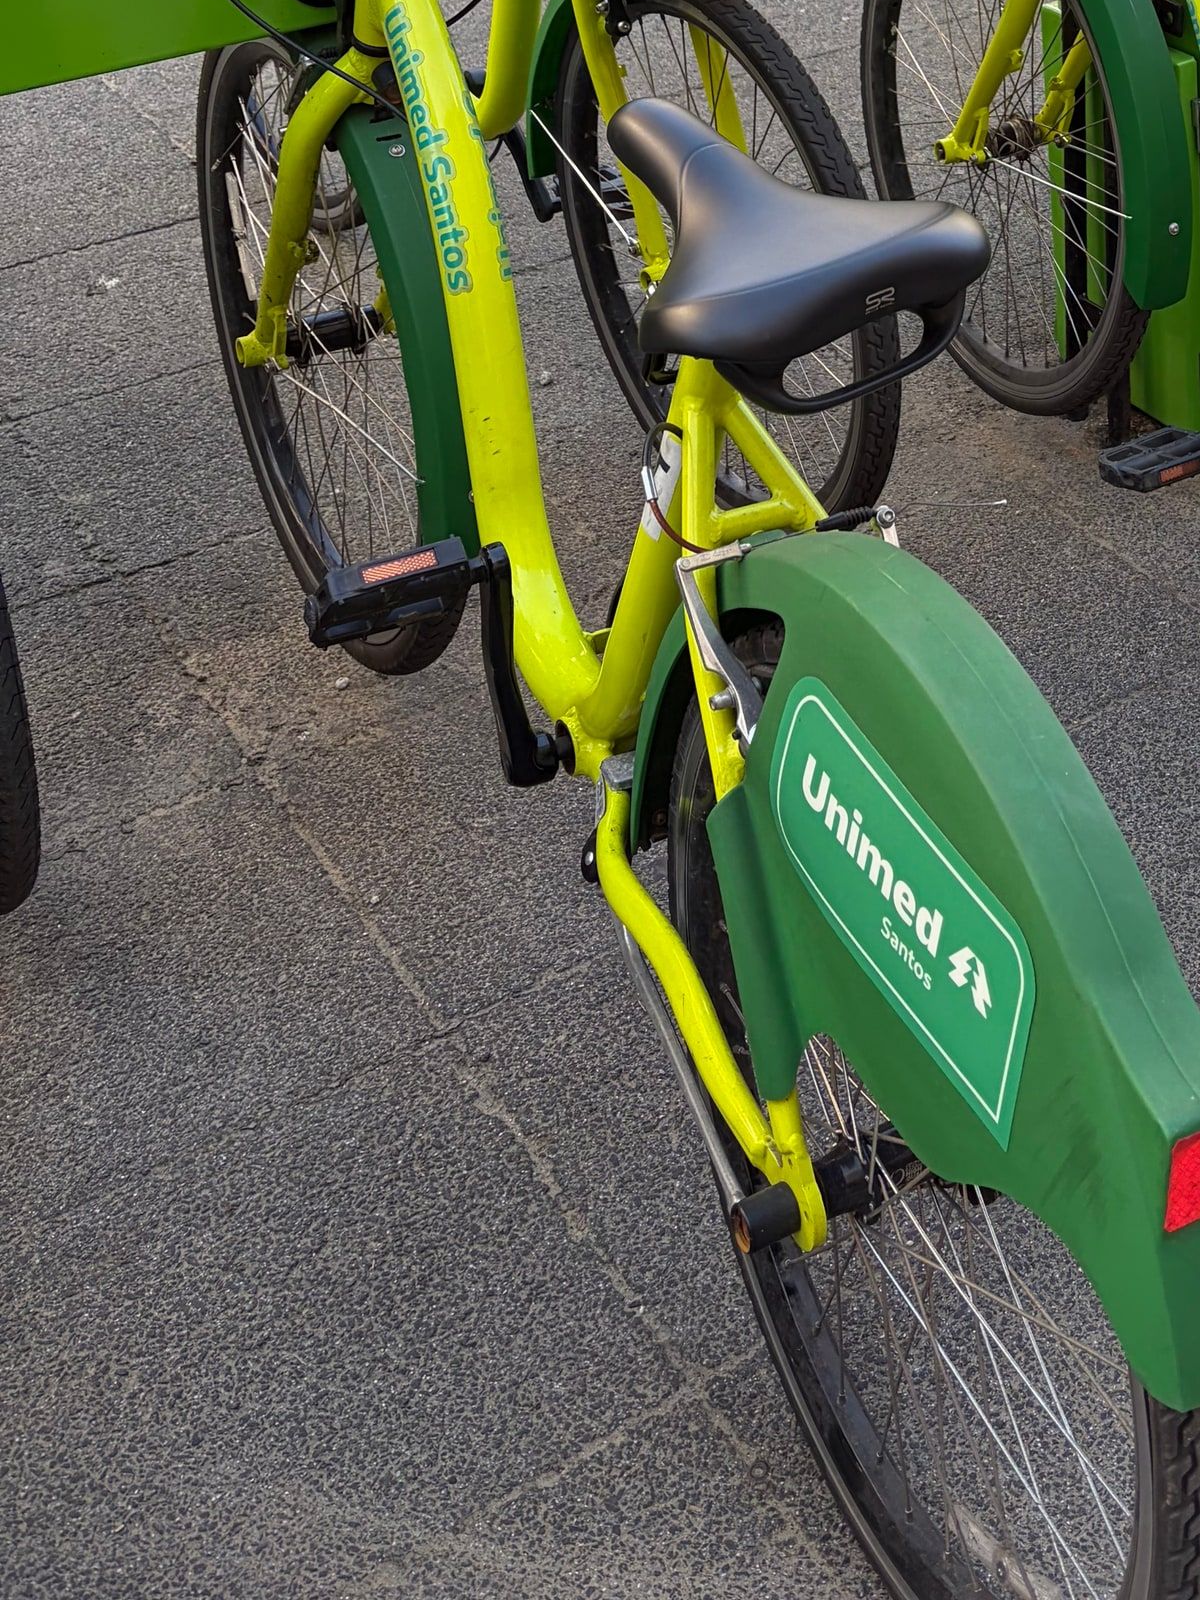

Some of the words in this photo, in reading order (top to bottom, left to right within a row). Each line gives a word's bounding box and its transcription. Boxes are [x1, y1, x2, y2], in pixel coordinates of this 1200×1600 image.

[385, 5, 446, 148] Unimed
[421, 155, 471, 294] Santos
[802, 752, 944, 958] Unimed
[880, 915, 933, 991] Santos
